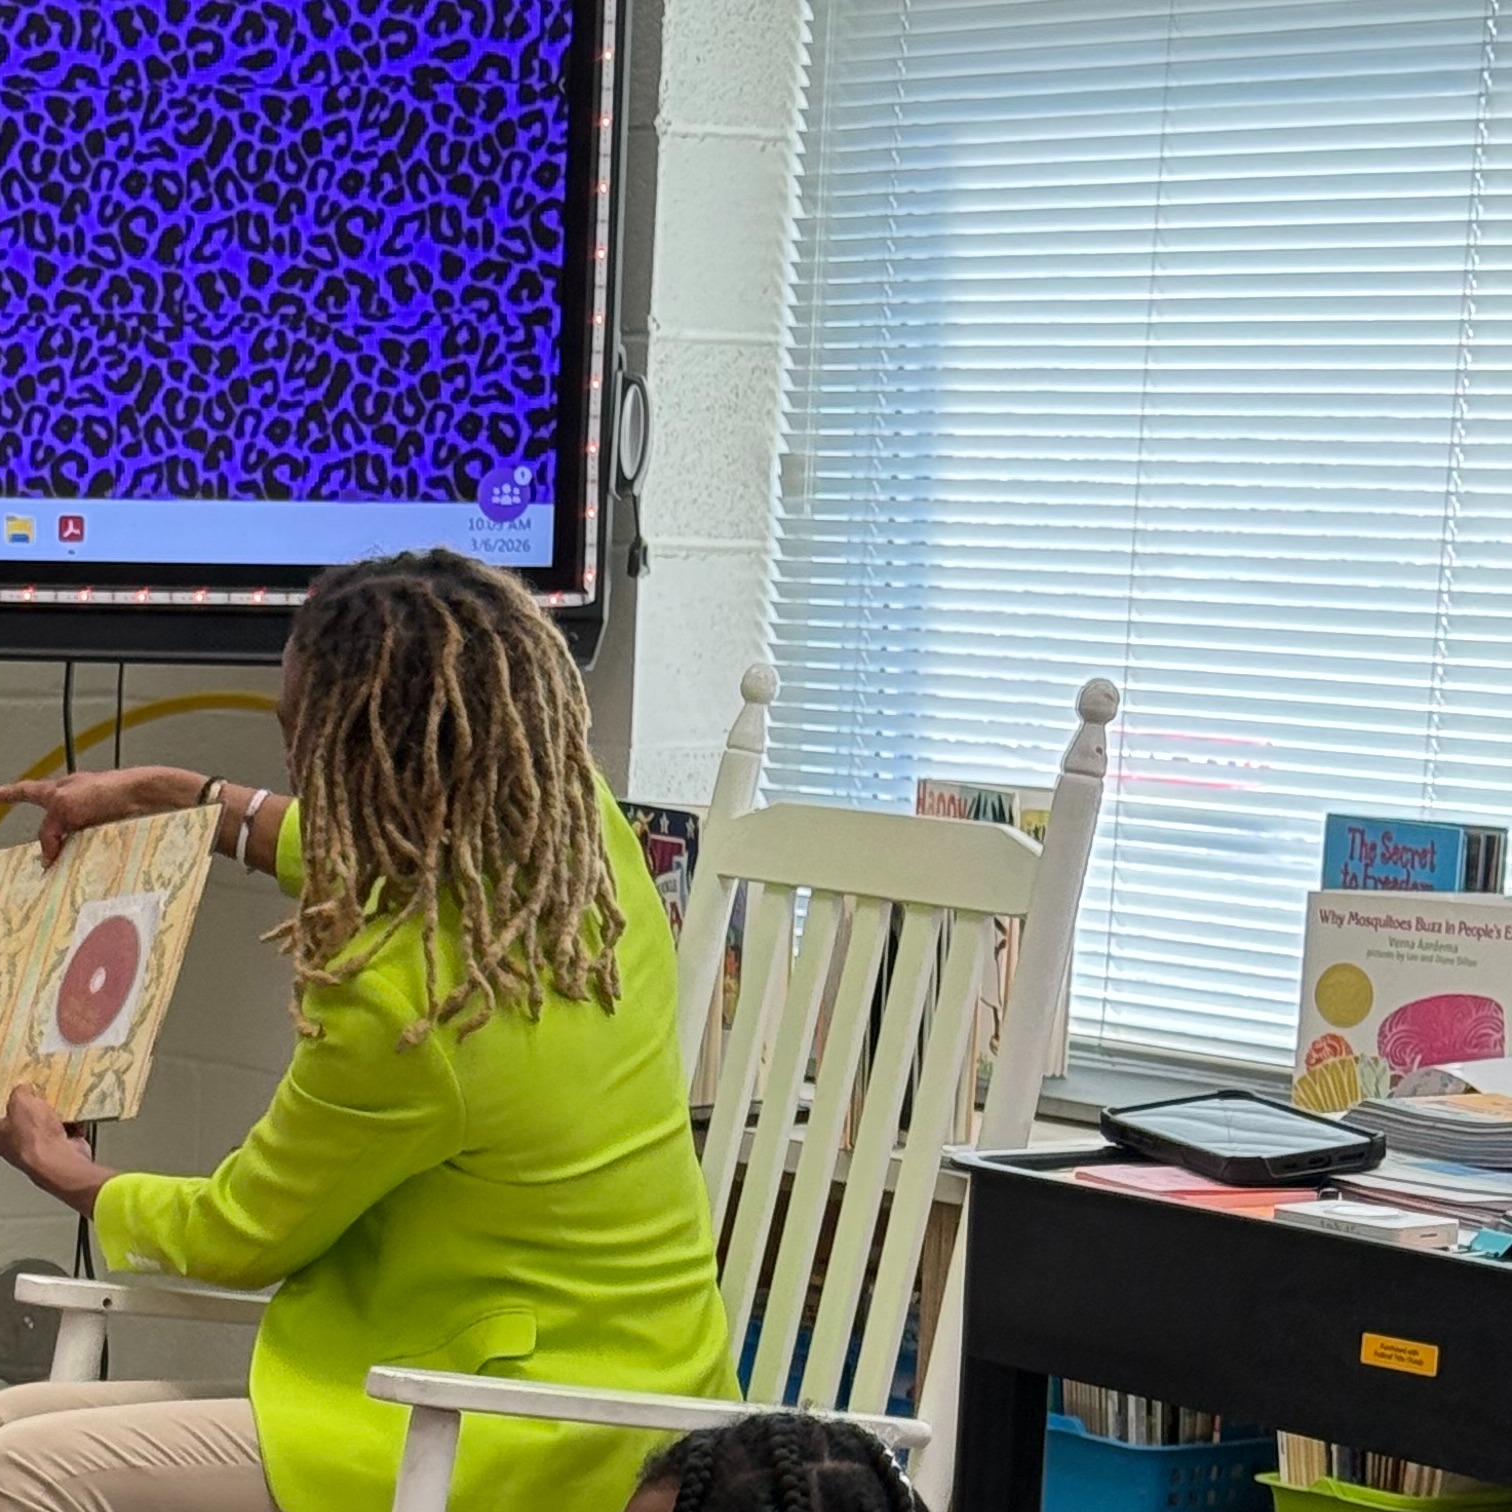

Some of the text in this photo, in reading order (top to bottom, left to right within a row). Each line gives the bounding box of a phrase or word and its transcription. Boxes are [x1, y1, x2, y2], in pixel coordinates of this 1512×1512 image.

[1347, 825, 1436, 873] The Secret
[1341, 861, 1359, 890] to
[1319, 909, 1347, 929] Why
[1347, 911, 1412, 932] Mosquitoes
[1415, 916, 1442, 934] Buzz
[1458, 919, 1502, 942] People's
